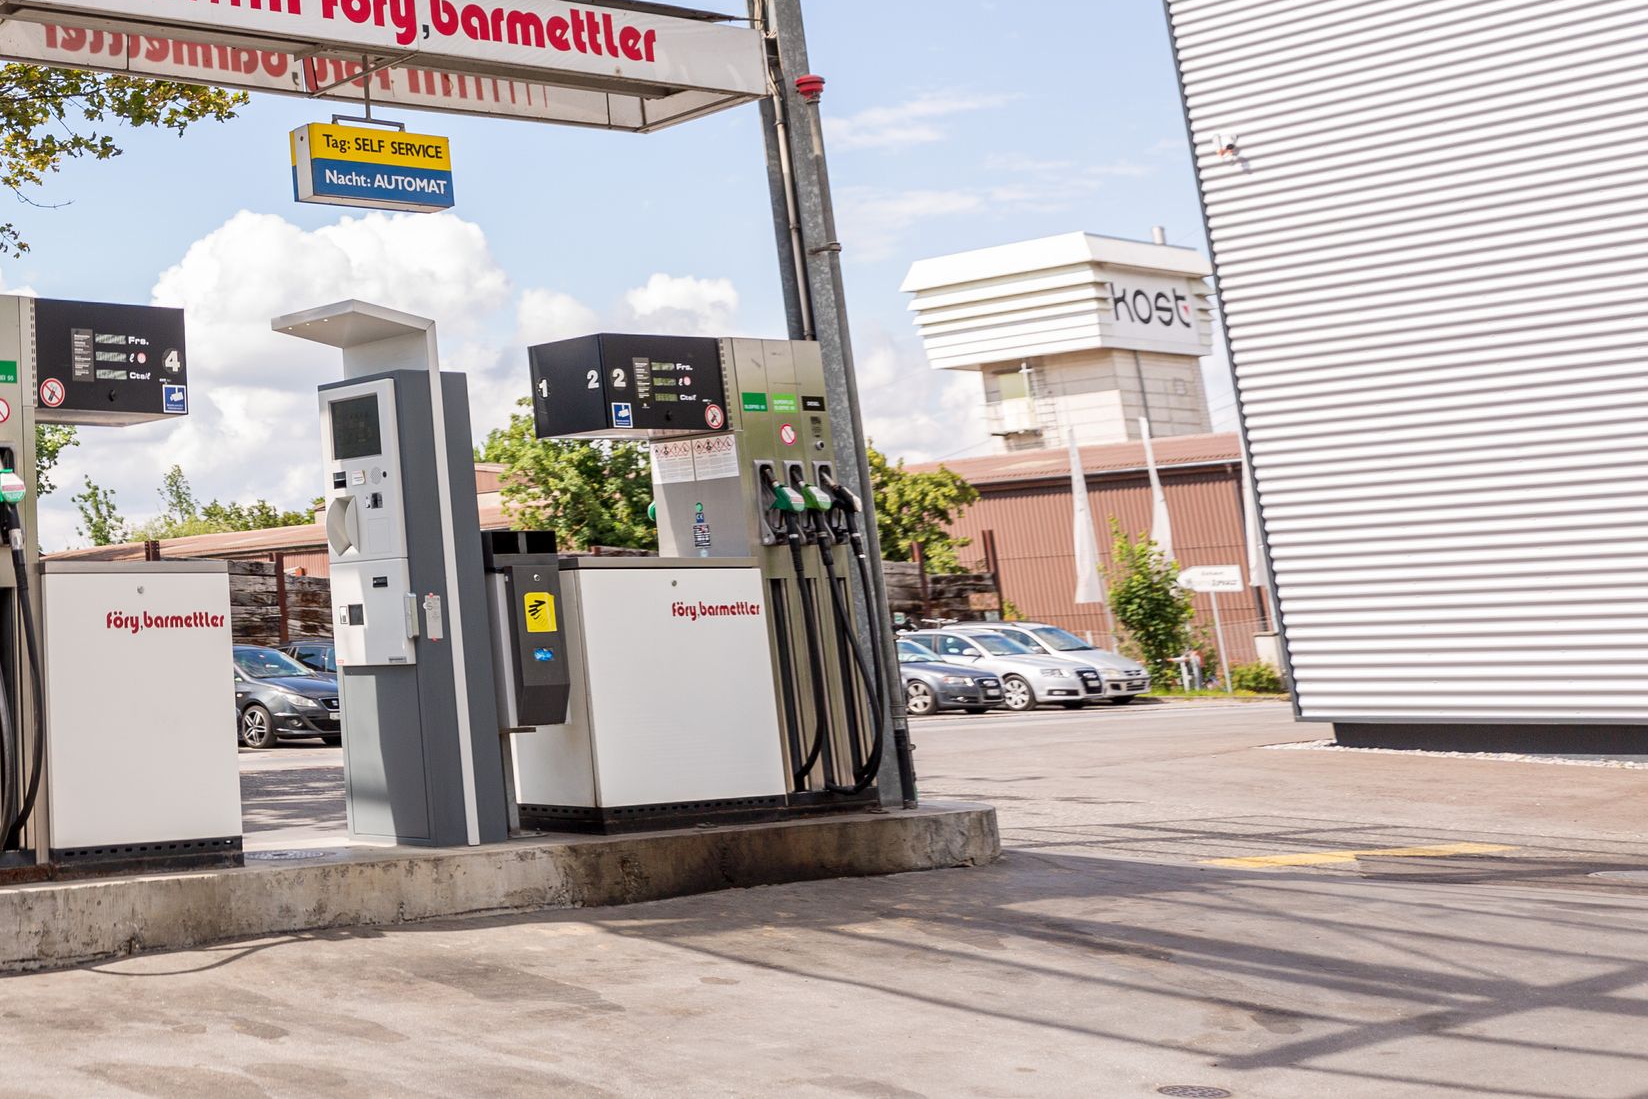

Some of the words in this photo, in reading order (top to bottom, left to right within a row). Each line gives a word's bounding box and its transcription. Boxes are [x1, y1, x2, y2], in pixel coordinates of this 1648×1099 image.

[322, 133, 351, 154] Tag:
[354, 137, 385, 153] SELF
[390, 141, 443, 159] SERVICE
[325, 168, 371, 187] Nacht:
[373, 173, 447, 194] AUTOMAT
[164, 350, 181, 373] 4
[538, 379, 548, 398] 1
[586, 369, 600, 390] 2
[612, 367, 627, 388] 2
